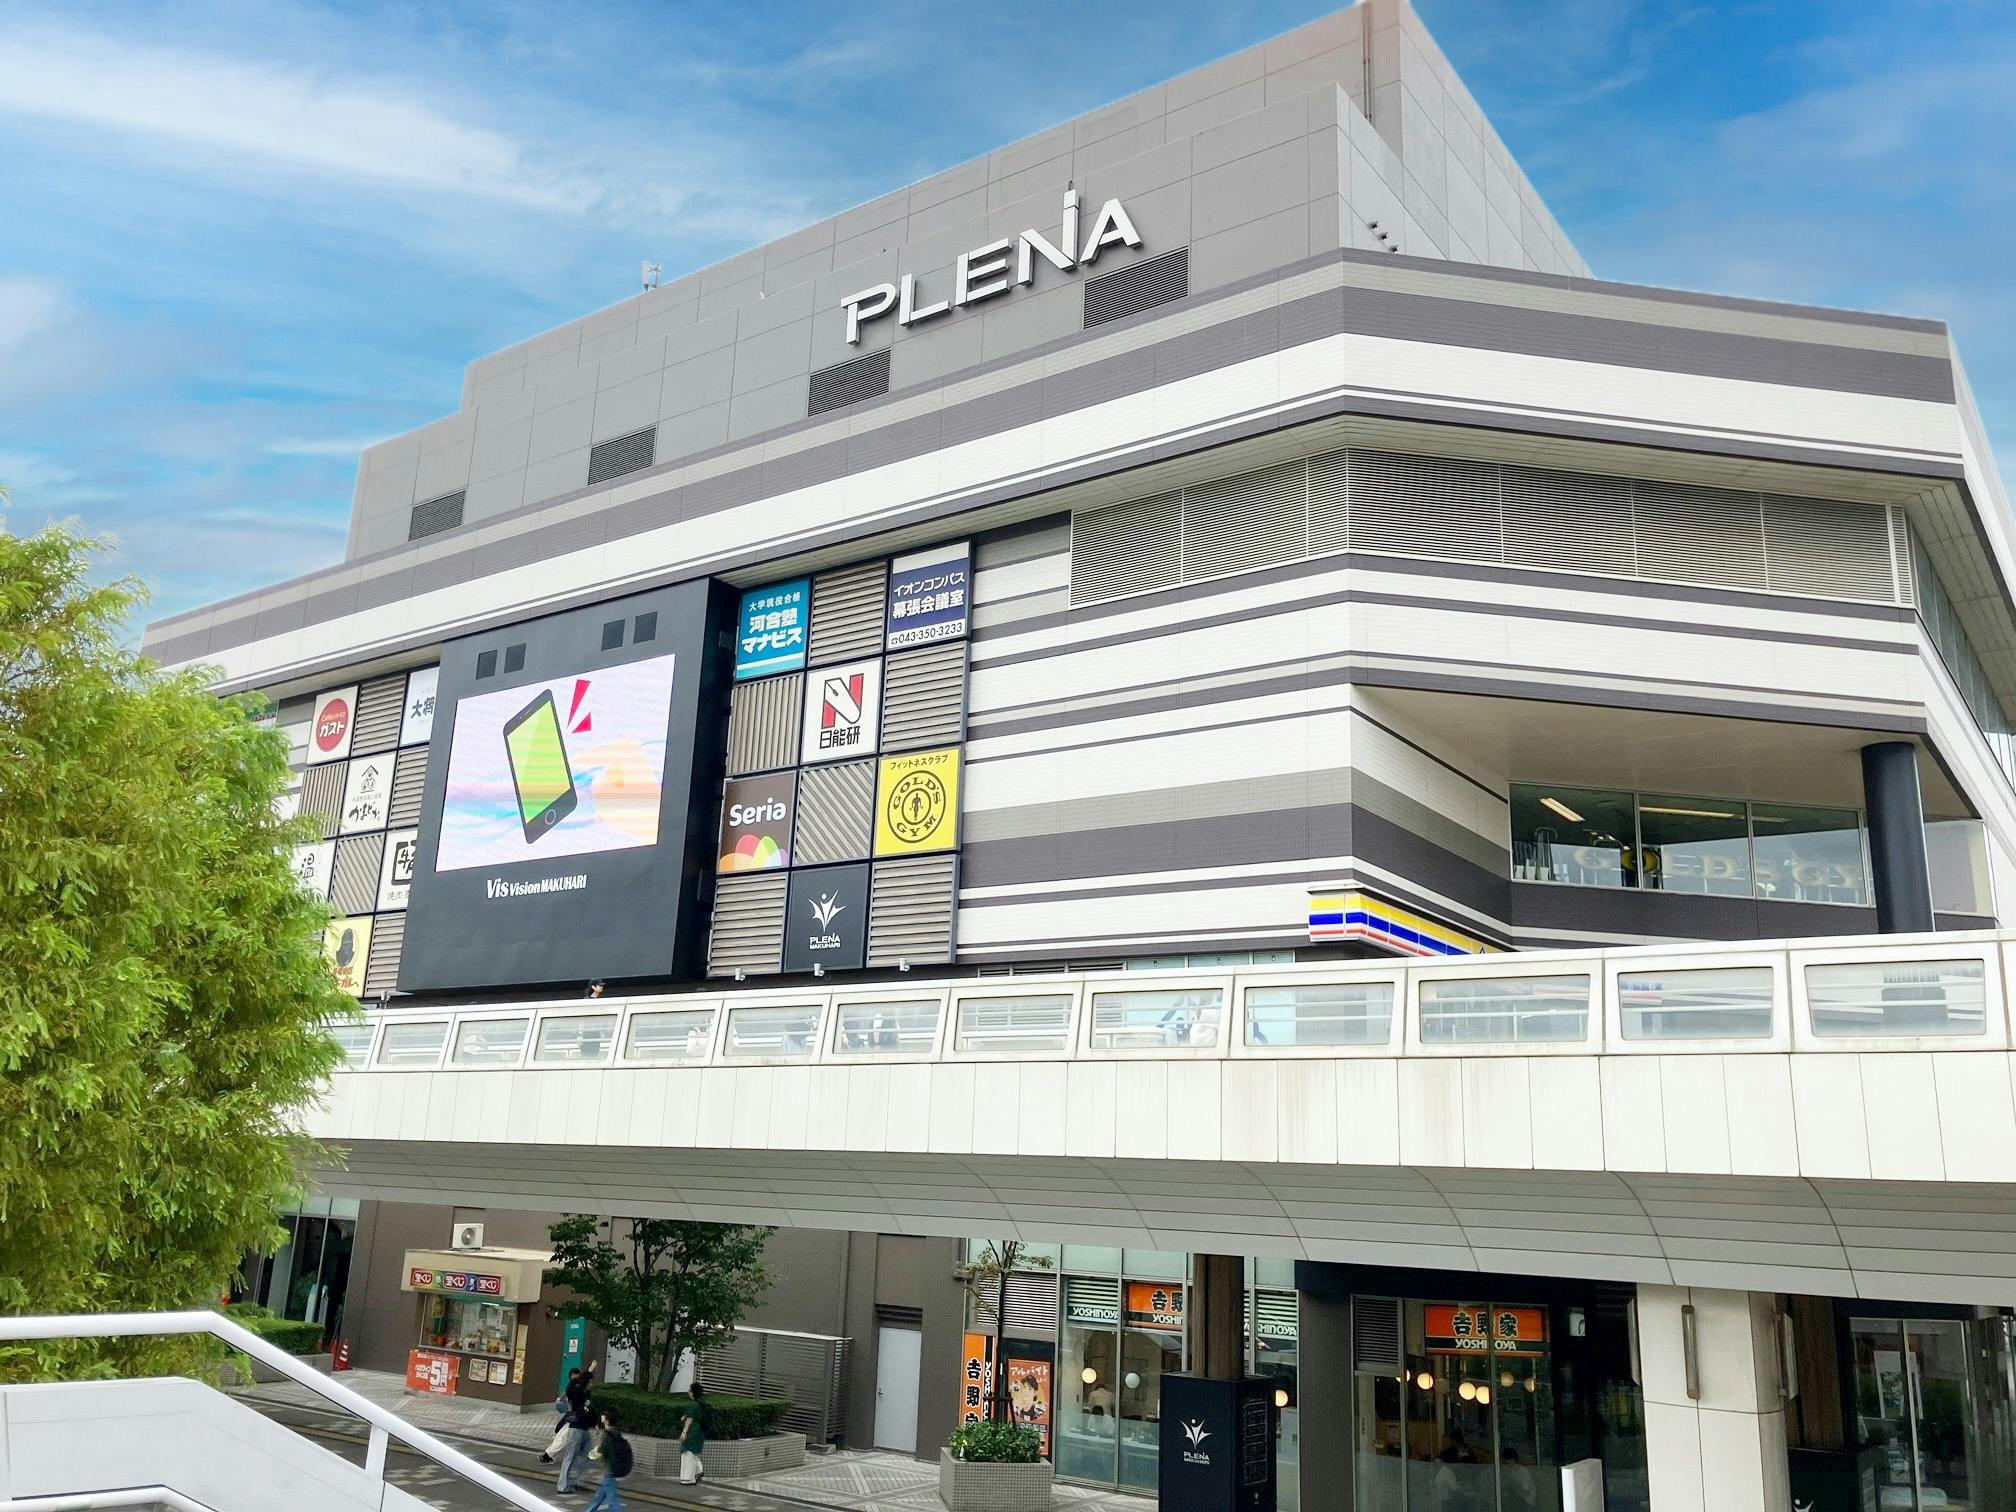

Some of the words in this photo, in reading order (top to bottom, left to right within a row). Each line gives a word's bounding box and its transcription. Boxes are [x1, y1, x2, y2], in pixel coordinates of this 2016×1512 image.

[841, 189, 1143, 345] PLENA
[894, 572, 965, 597] イオンコンパス
[893, 589, 964, 619] 幕張会議室
[749, 608, 797, 633] 河合塾
[742, 627, 802, 653] マナビス
[900, 622, 963, 644] 043-350-3233
[320, 721, 345, 737] ガスト
[820, 726, 860, 749] 日能研
[890, 754, 949, 770] フィットネスクラブ
[729, 797, 787, 827] Seria
[896, 815, 936, 837] GYM
[487, 878, 509, 898] Vis
[509, 881, 541, 896] Vision
[541, 874, 587, 892] MAKUHARI
[809, 932, 840, 944] PLENA
[1455, 1338, 1517, 1351] YOSHIOYA
